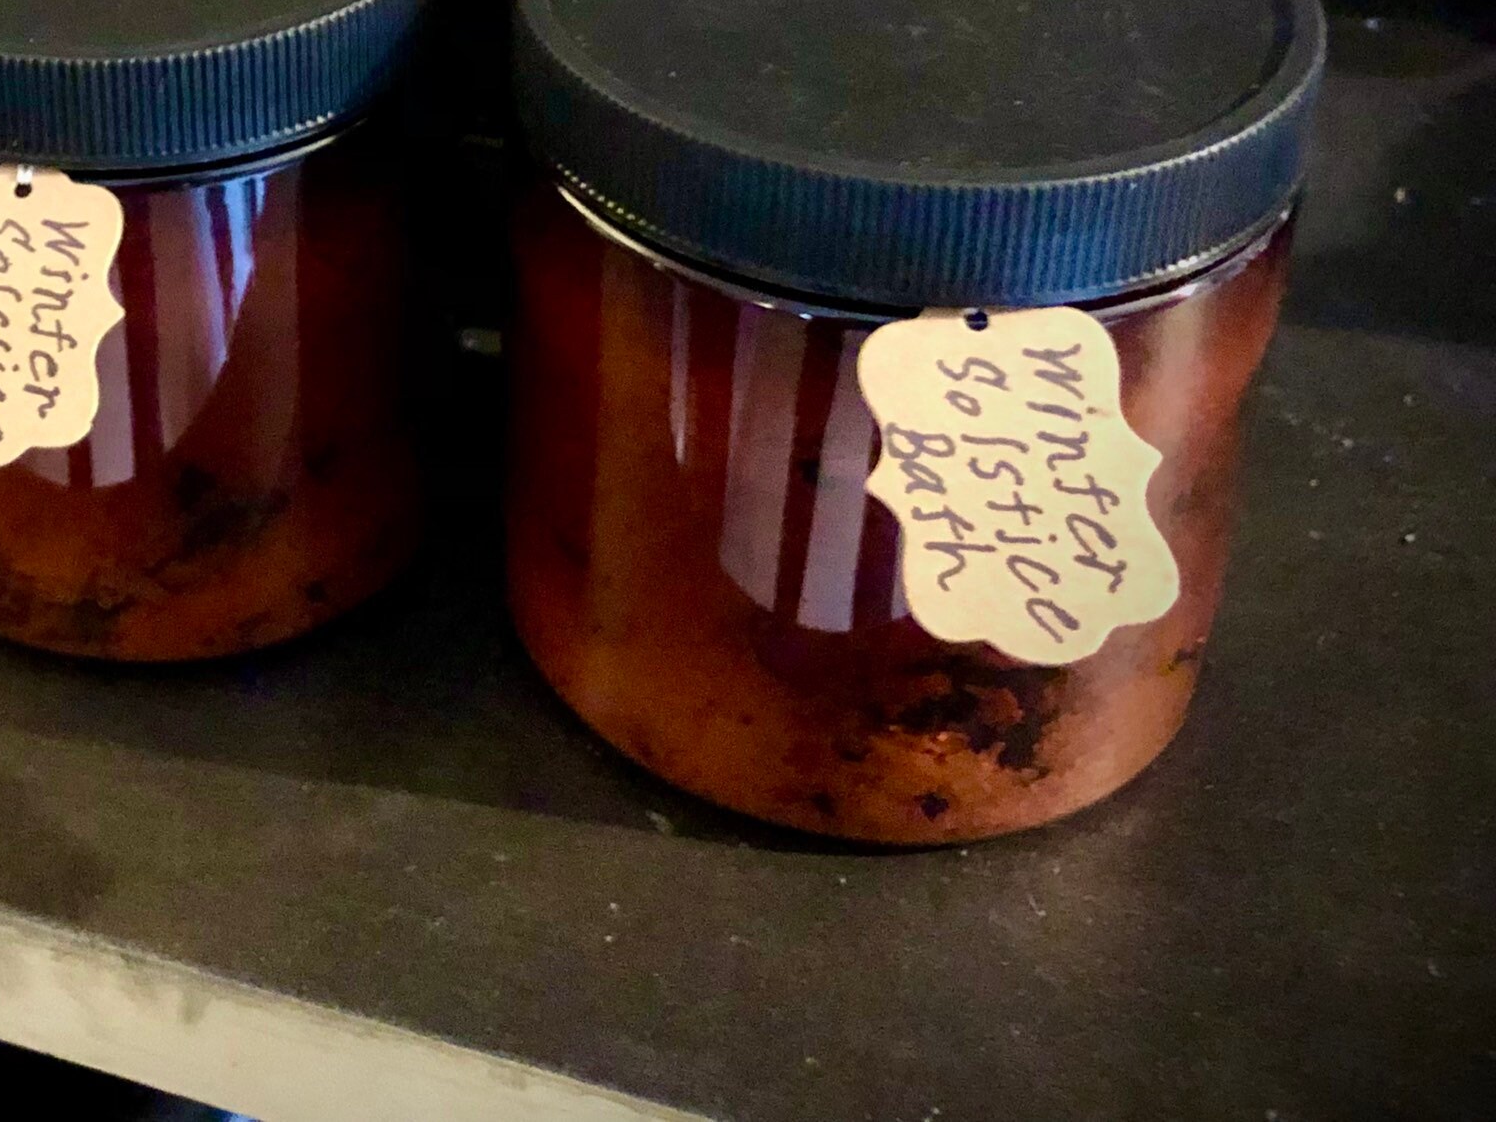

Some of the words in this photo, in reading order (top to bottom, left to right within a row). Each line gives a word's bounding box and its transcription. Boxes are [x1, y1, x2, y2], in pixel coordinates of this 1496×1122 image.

[23, 218, 90, 419] Winter
[885, 422, 997, 592] Bath
[936, 357, 1080, 644] Solstice
[1021, 343, 1128, 594] Winter
